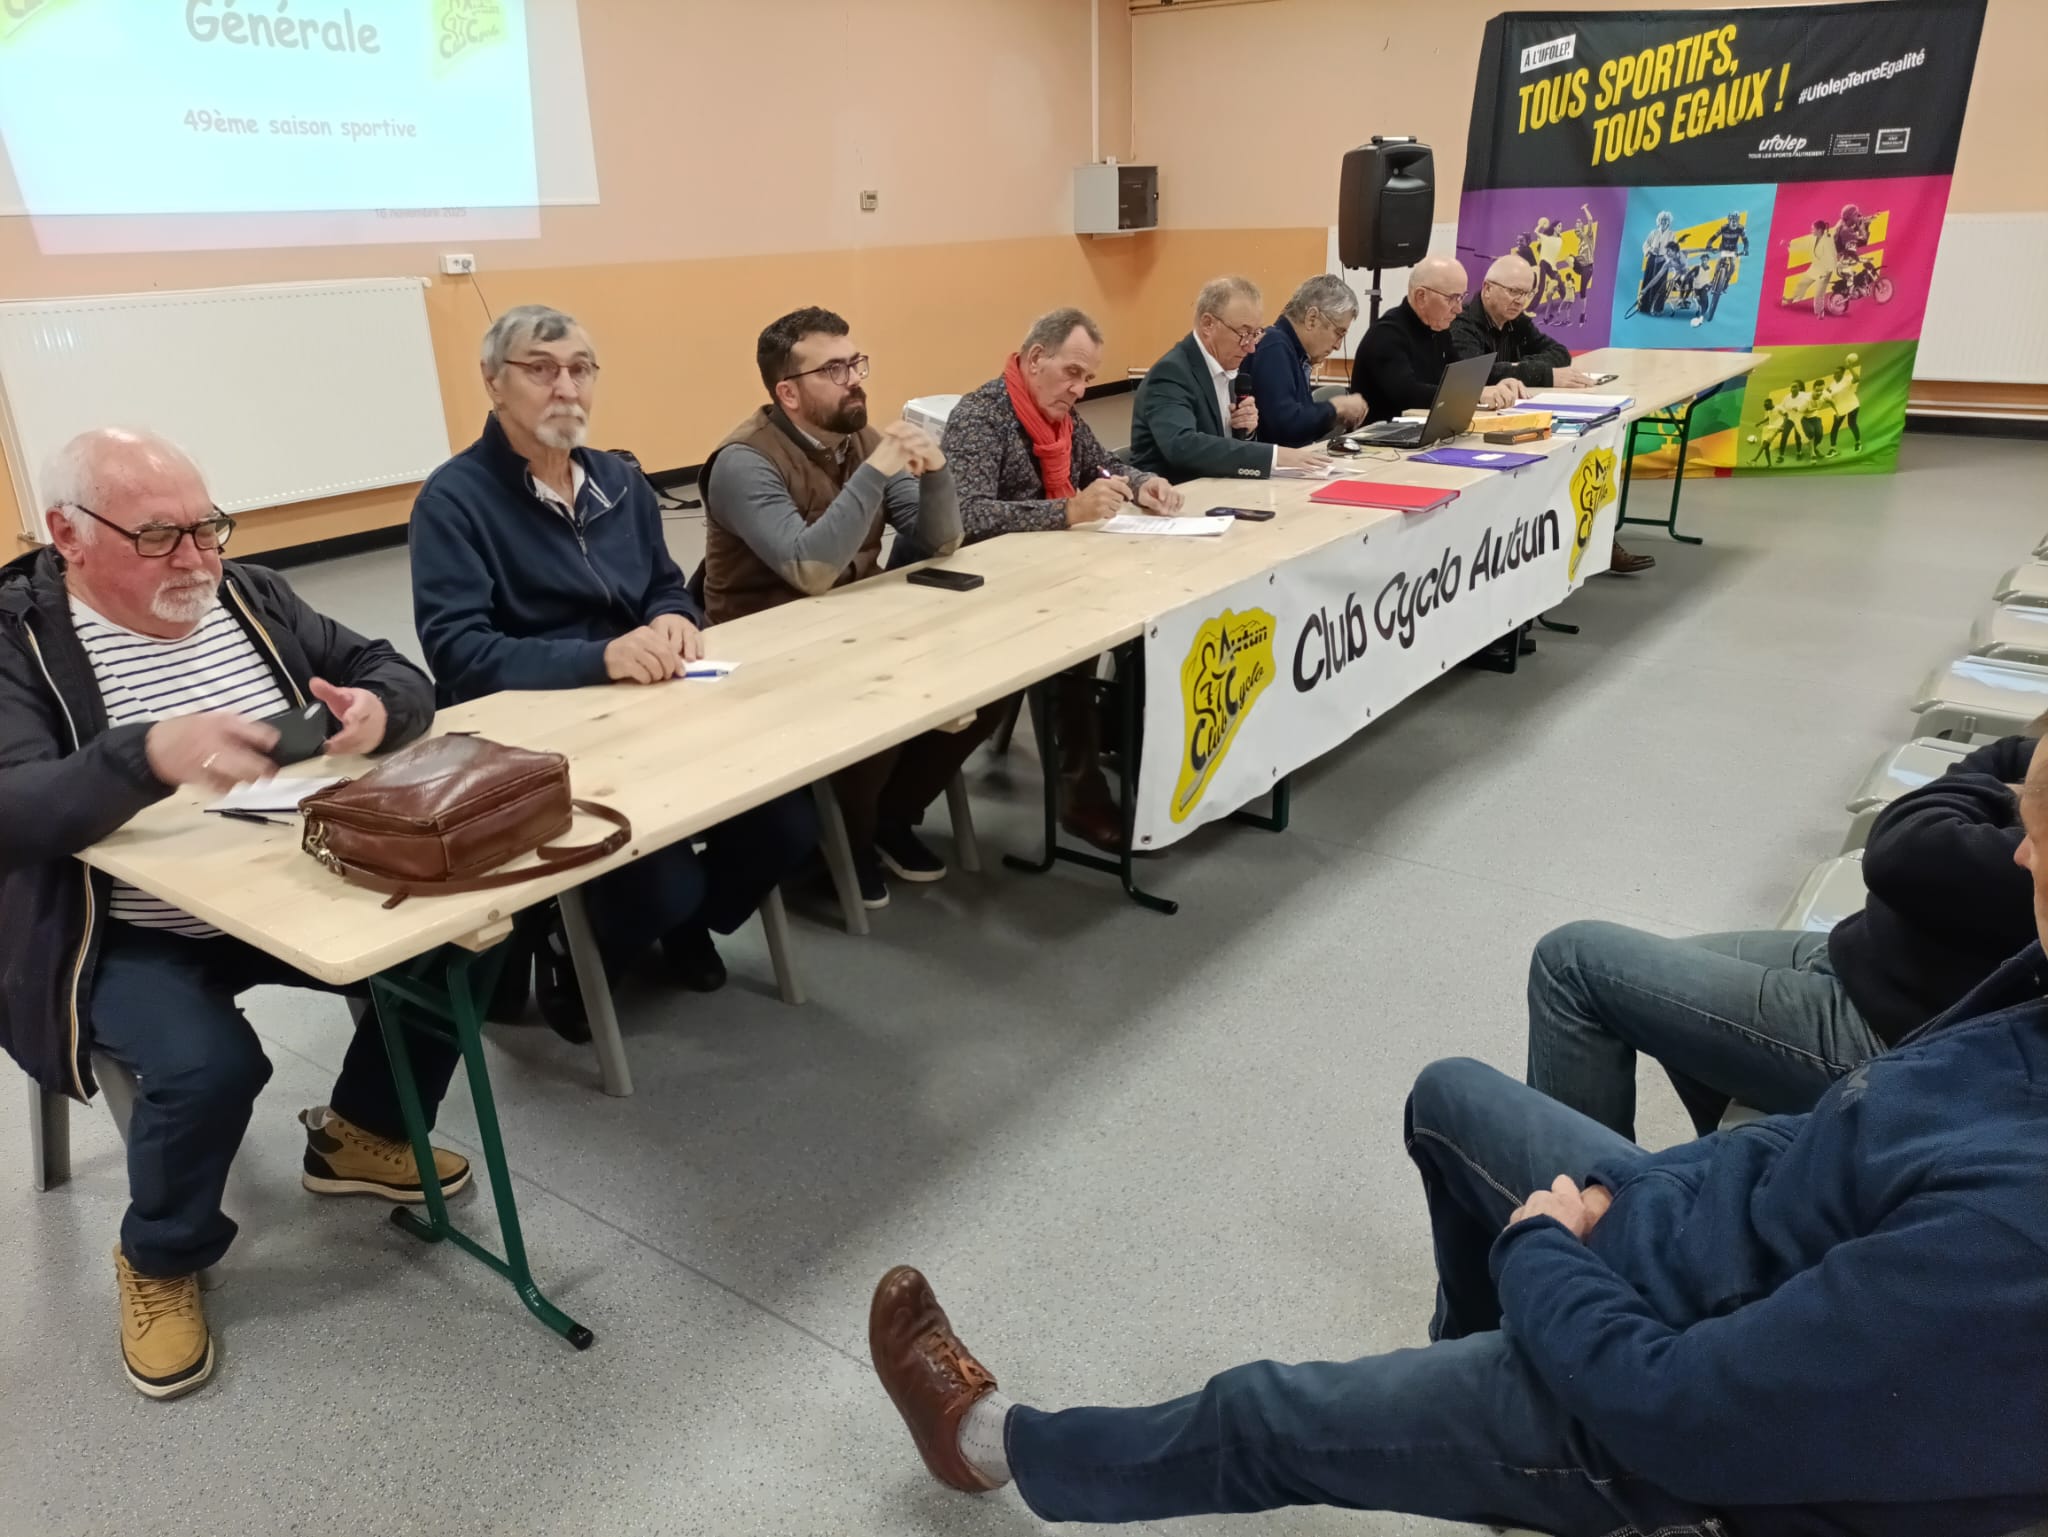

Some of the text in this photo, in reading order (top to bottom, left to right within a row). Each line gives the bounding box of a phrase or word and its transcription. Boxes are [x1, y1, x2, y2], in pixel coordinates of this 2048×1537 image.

[185, 0, 381, 54] Générale
[1518, 24, 1739, 134] TOUS SPORTIFS,
[1798, 48, 1926, 104] #UfolepTerreEgalité
[183, 108, 417, 142] 49ème saison sportive
[1591, 62, 1791, 167] TOUS EGAUX !
[1758, 134, 1808, 158] ufolep
[1293, 509, 1560, 693] Club Cyclo Autun
[1225, 661, 1264, 716] Cyclo
[1191, 712, 1228, 771] Club
